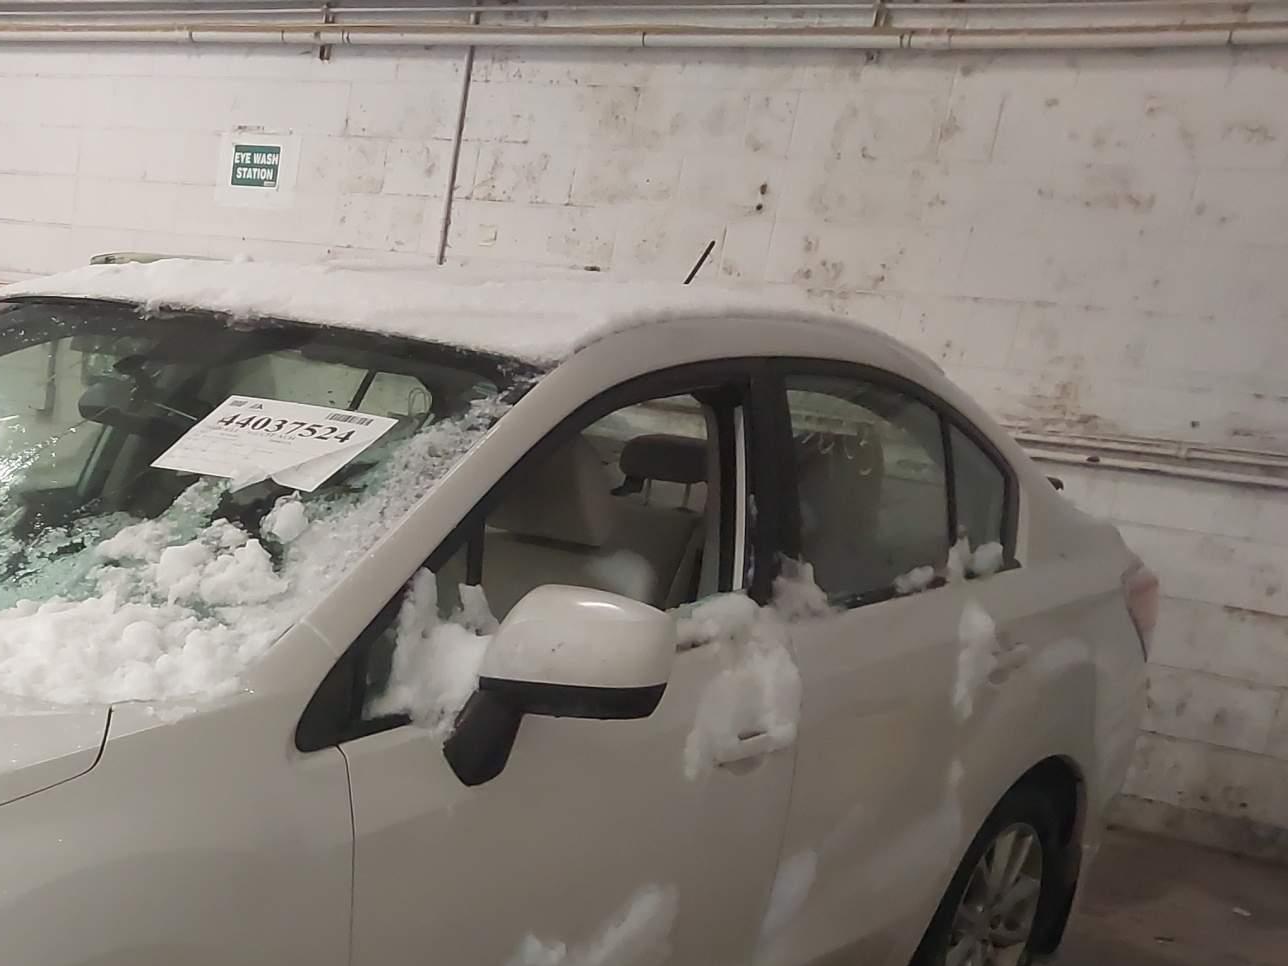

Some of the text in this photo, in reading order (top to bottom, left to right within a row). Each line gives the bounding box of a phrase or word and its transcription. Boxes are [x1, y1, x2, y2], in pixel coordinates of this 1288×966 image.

[234, 152, 279, 165] EYE WASH
[236, 167, 274, 180] STATION
[218, 413, 356, 443] 44037524
